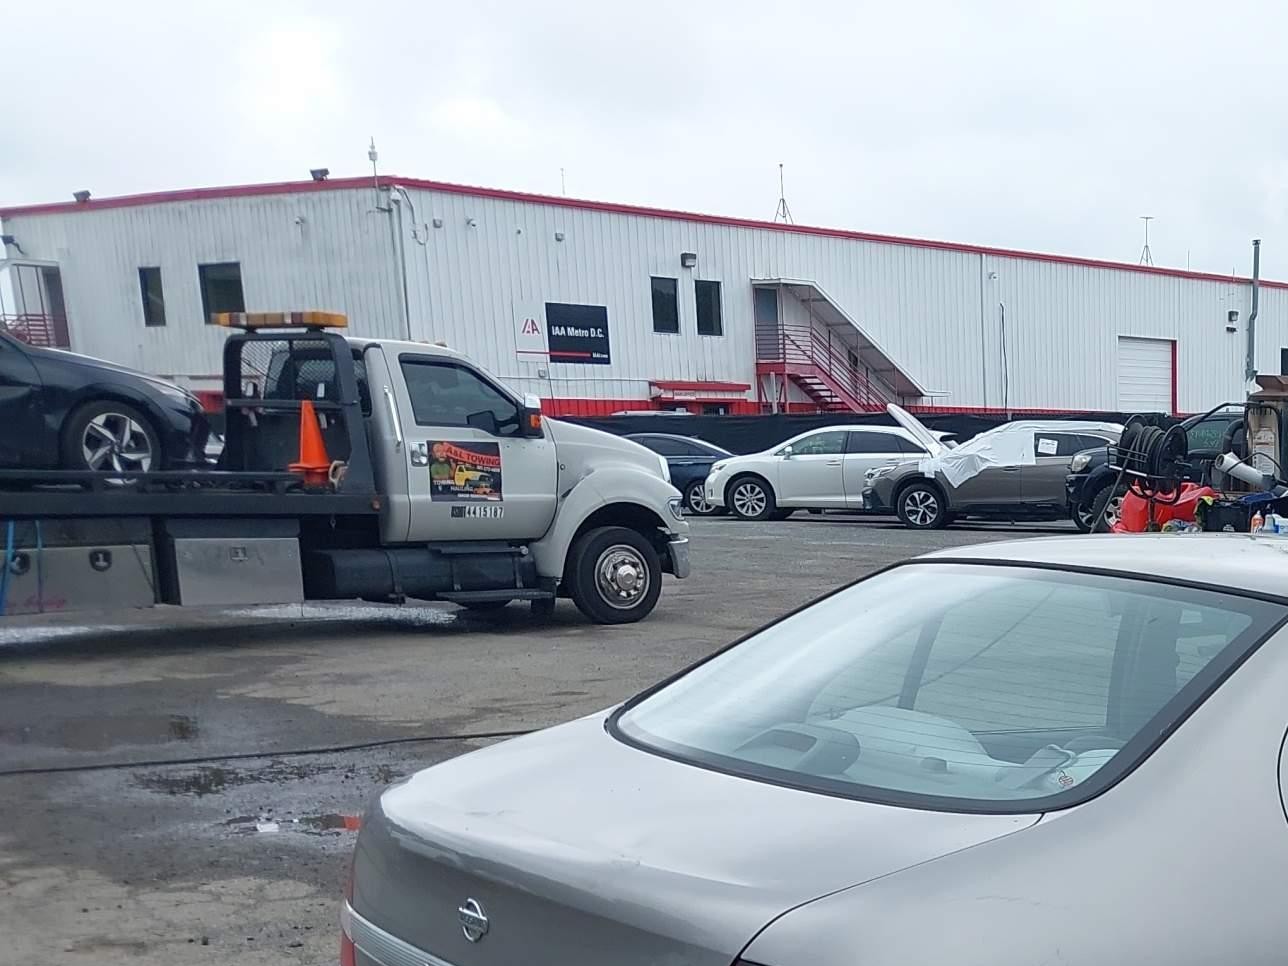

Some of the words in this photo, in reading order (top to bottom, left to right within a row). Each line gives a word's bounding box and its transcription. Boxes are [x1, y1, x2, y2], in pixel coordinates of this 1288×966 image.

[551, 325, 566, 336] IAA
[567, 326, 589, 337] Metro
[590, 328, 605, 338] D.C.
[466, 453, 501, 466] TOWING
